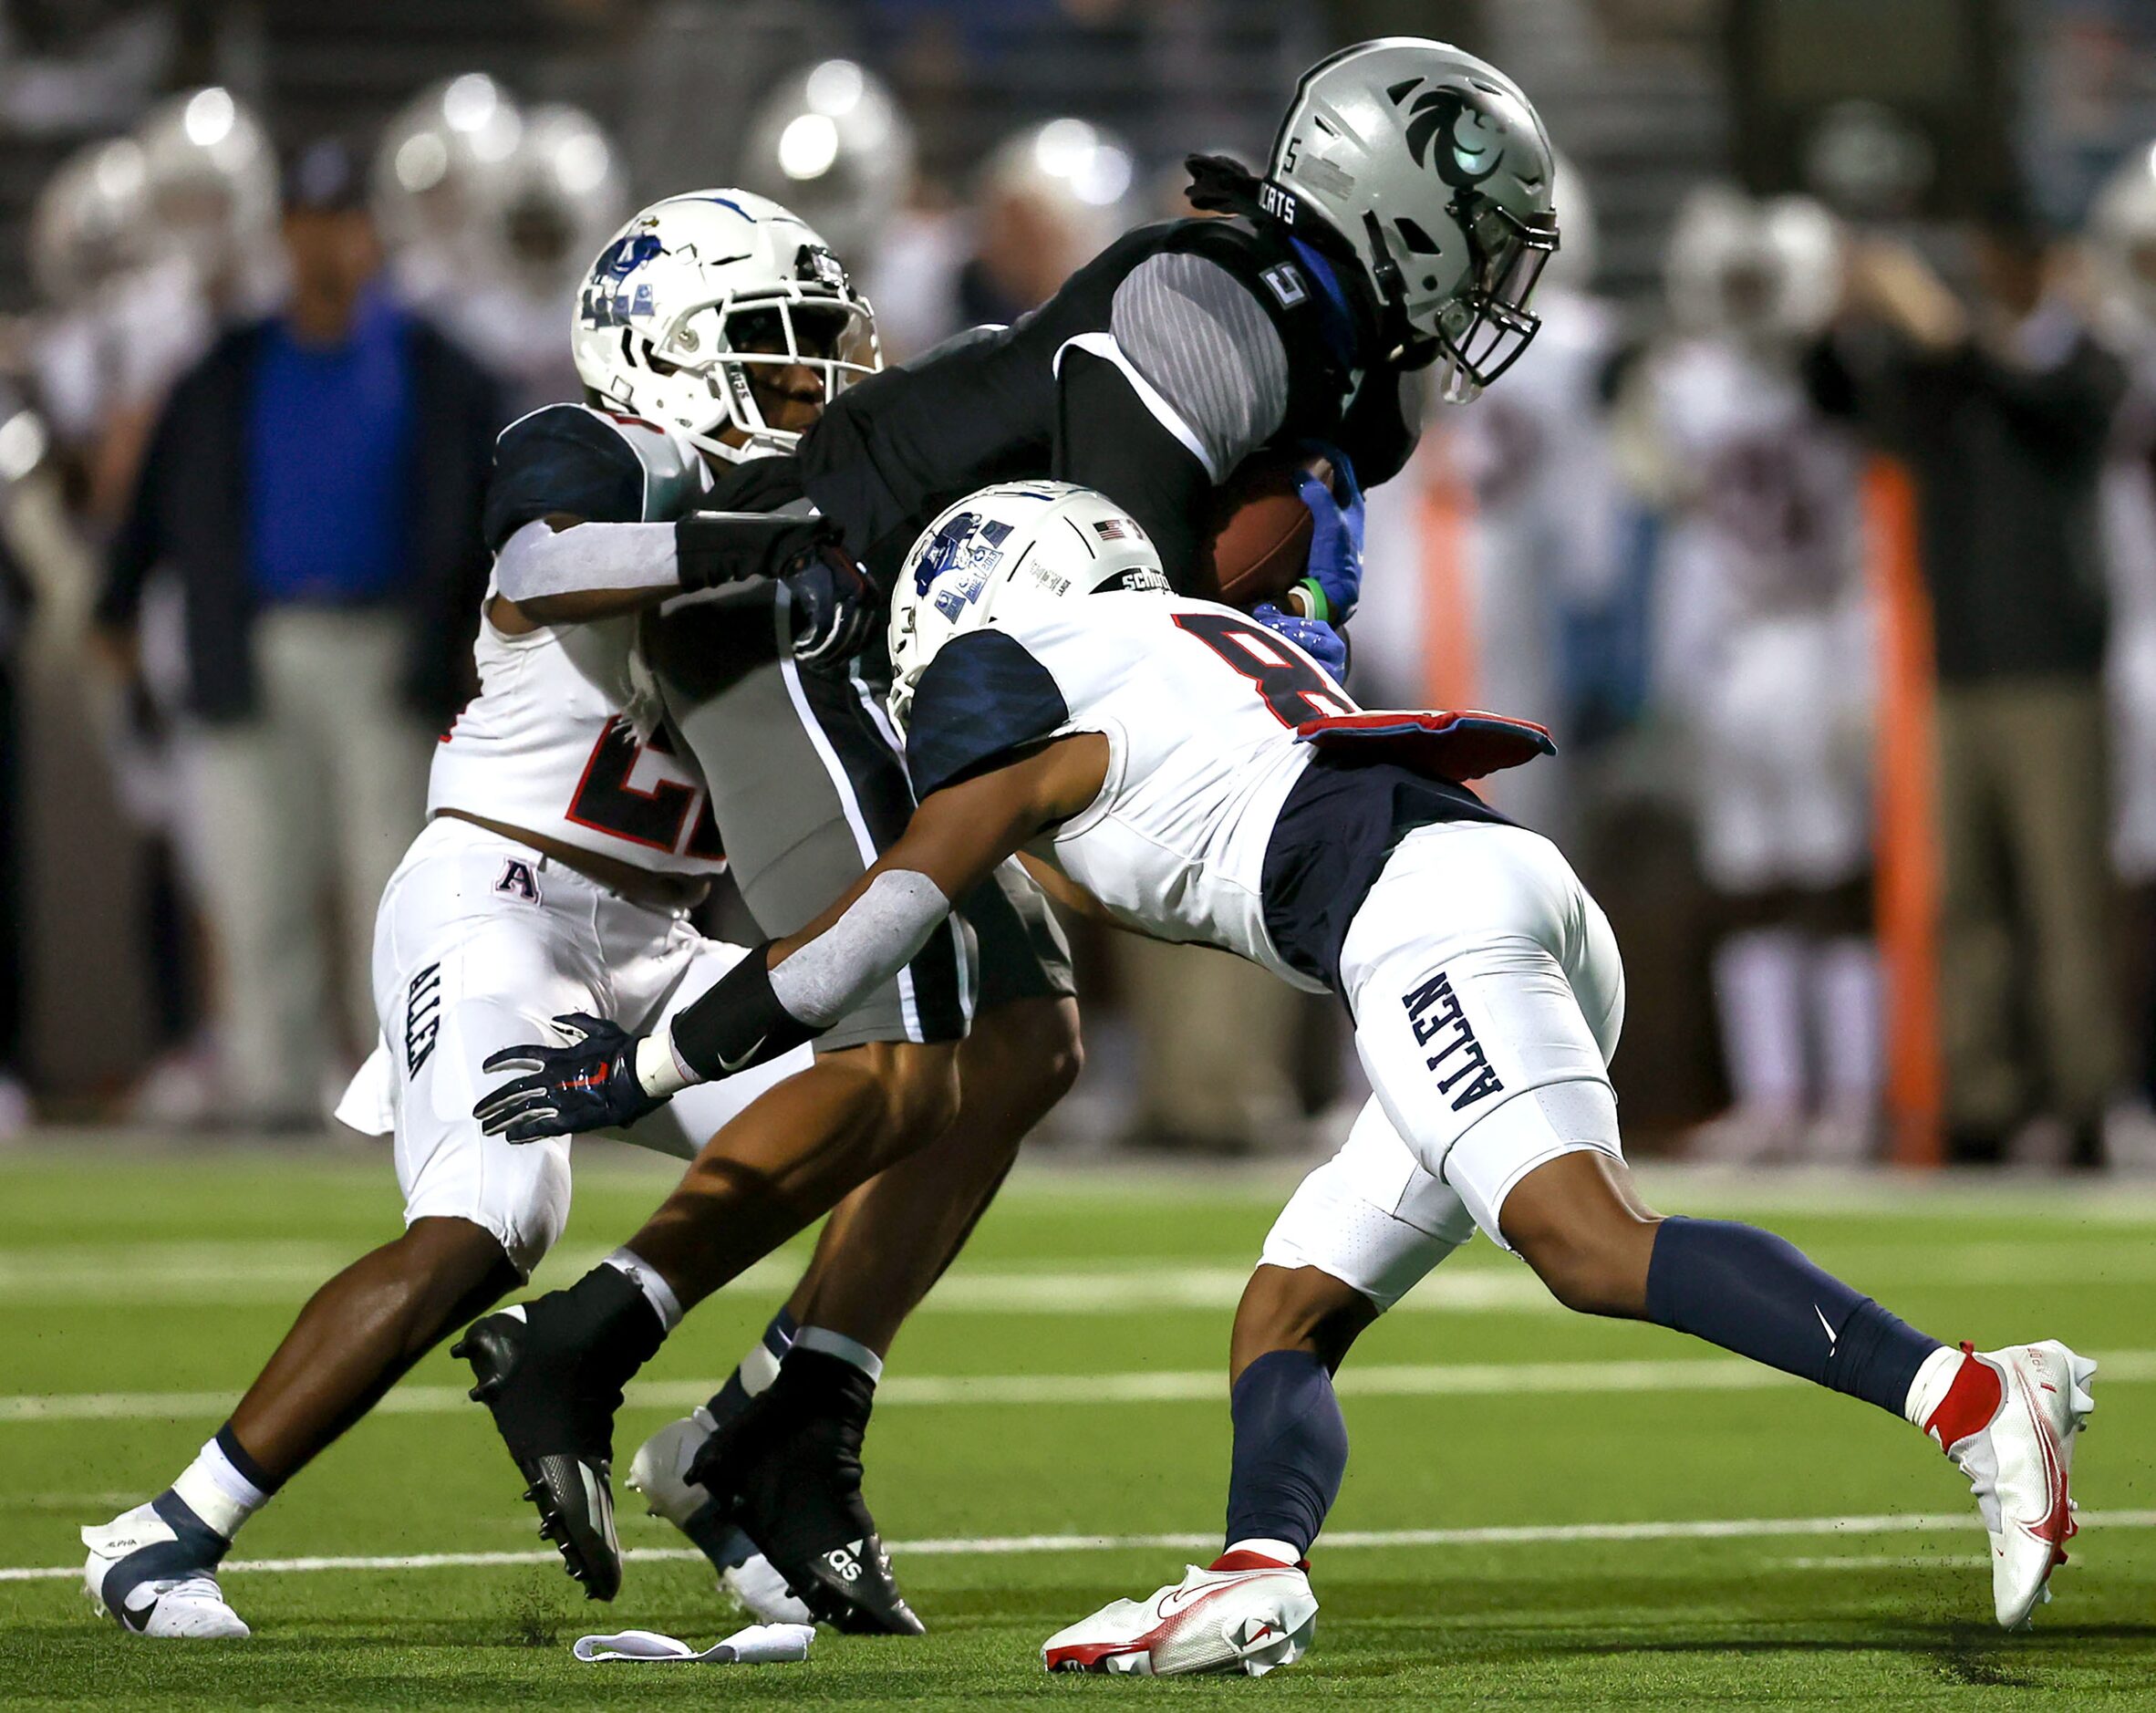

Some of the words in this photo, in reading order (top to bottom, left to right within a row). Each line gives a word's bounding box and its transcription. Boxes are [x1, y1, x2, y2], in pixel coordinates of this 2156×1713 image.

[1283, 137, 1301, 173] 5
[1171, 614, 1355, 730] 8
[495, 859, 544, 905] A
[405, 961, 441, 1083] ALLEN
[1402, 971, 1505, 1112] ALLEN
